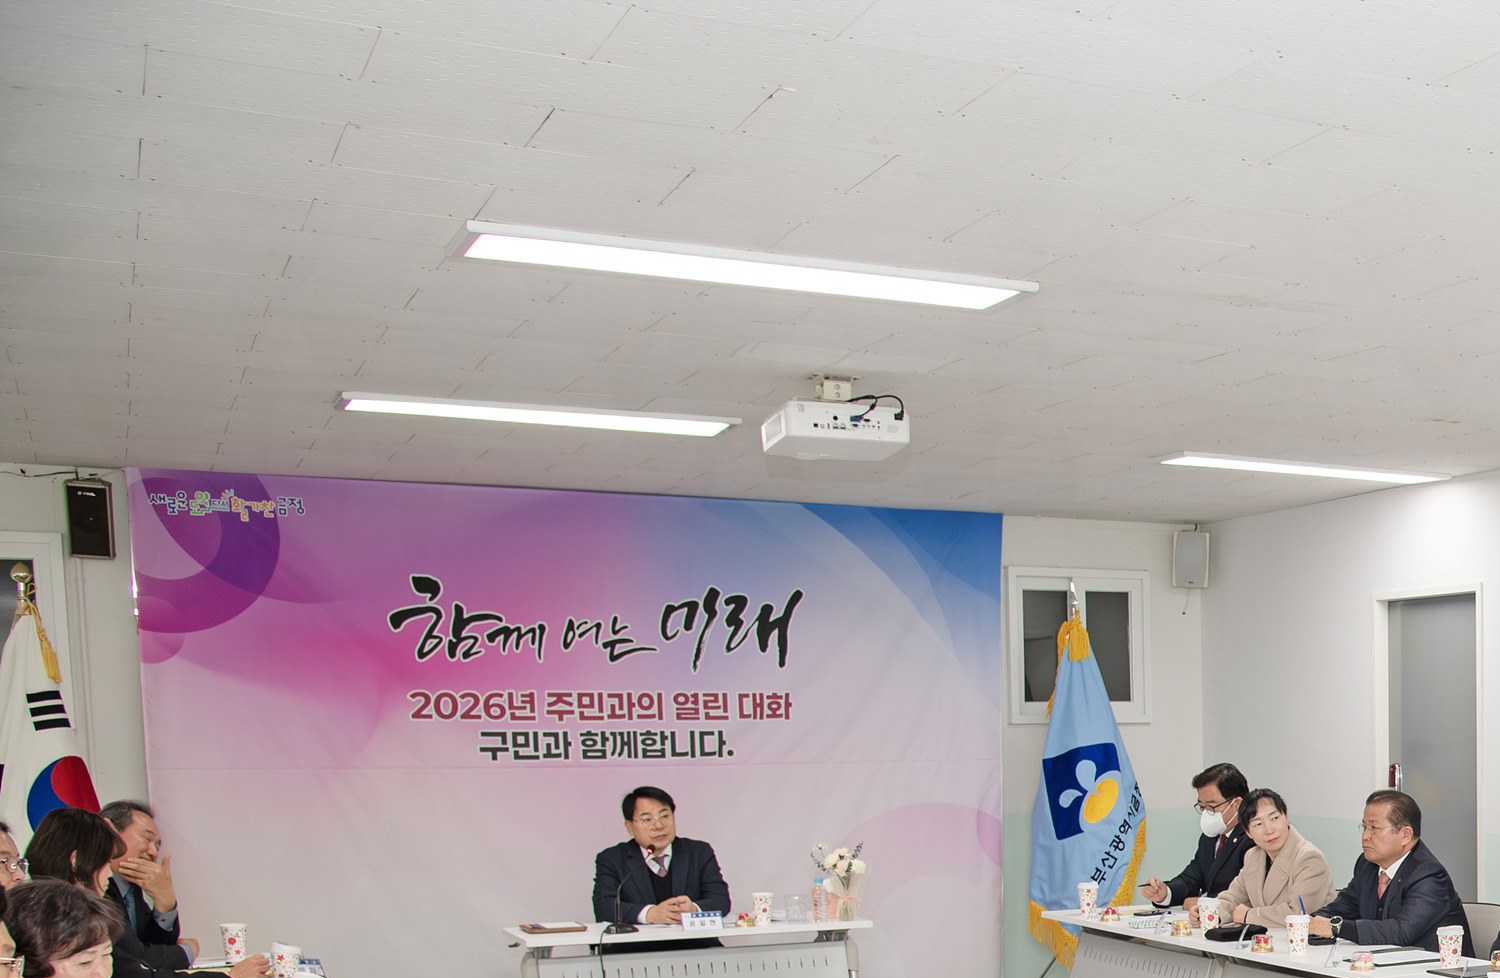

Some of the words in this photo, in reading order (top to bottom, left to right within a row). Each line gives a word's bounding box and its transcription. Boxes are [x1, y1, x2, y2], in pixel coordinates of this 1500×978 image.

[150, 491, 187, 515] 새로운
[231, 497, 275, 521] 활기찬
[278, 497, 305, 516] 금정
[388, 573, 546, 662] 함께
[561, 615, 658, 662] 여는
[660, 586, 804, 672] 미래
[408, 691, 538, 722] 2026년
[545, 691, 665, 722] 주민과의
[672, 691, 730, 722] 열린
[738, 691, 793, 722] 대화
[479, 730, 571, 761] 구민과
[580, 729, 735, 761] 함께합니다.
